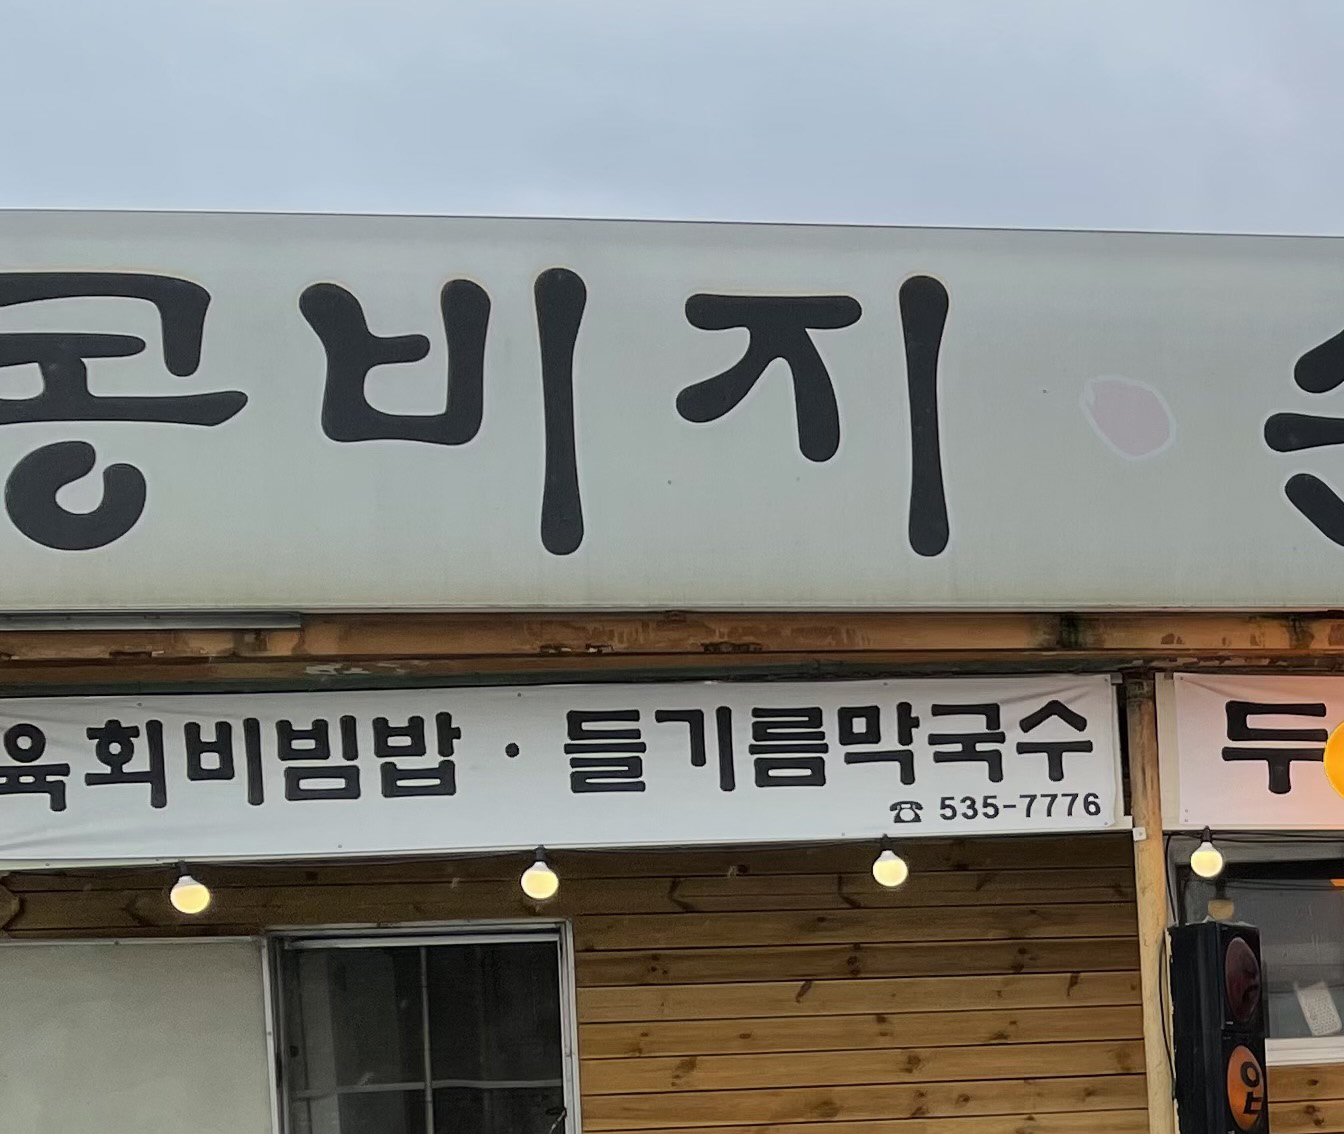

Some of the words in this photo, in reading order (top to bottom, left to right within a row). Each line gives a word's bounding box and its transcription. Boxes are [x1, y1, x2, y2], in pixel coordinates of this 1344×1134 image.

[0, 268, 949, 556] 콩비지
[0, 715, 461, 811] 육회비빔밥
[564, 700, 1093, 793] 들기름막국수
[940, 793, 1101, 820] 535-7776
